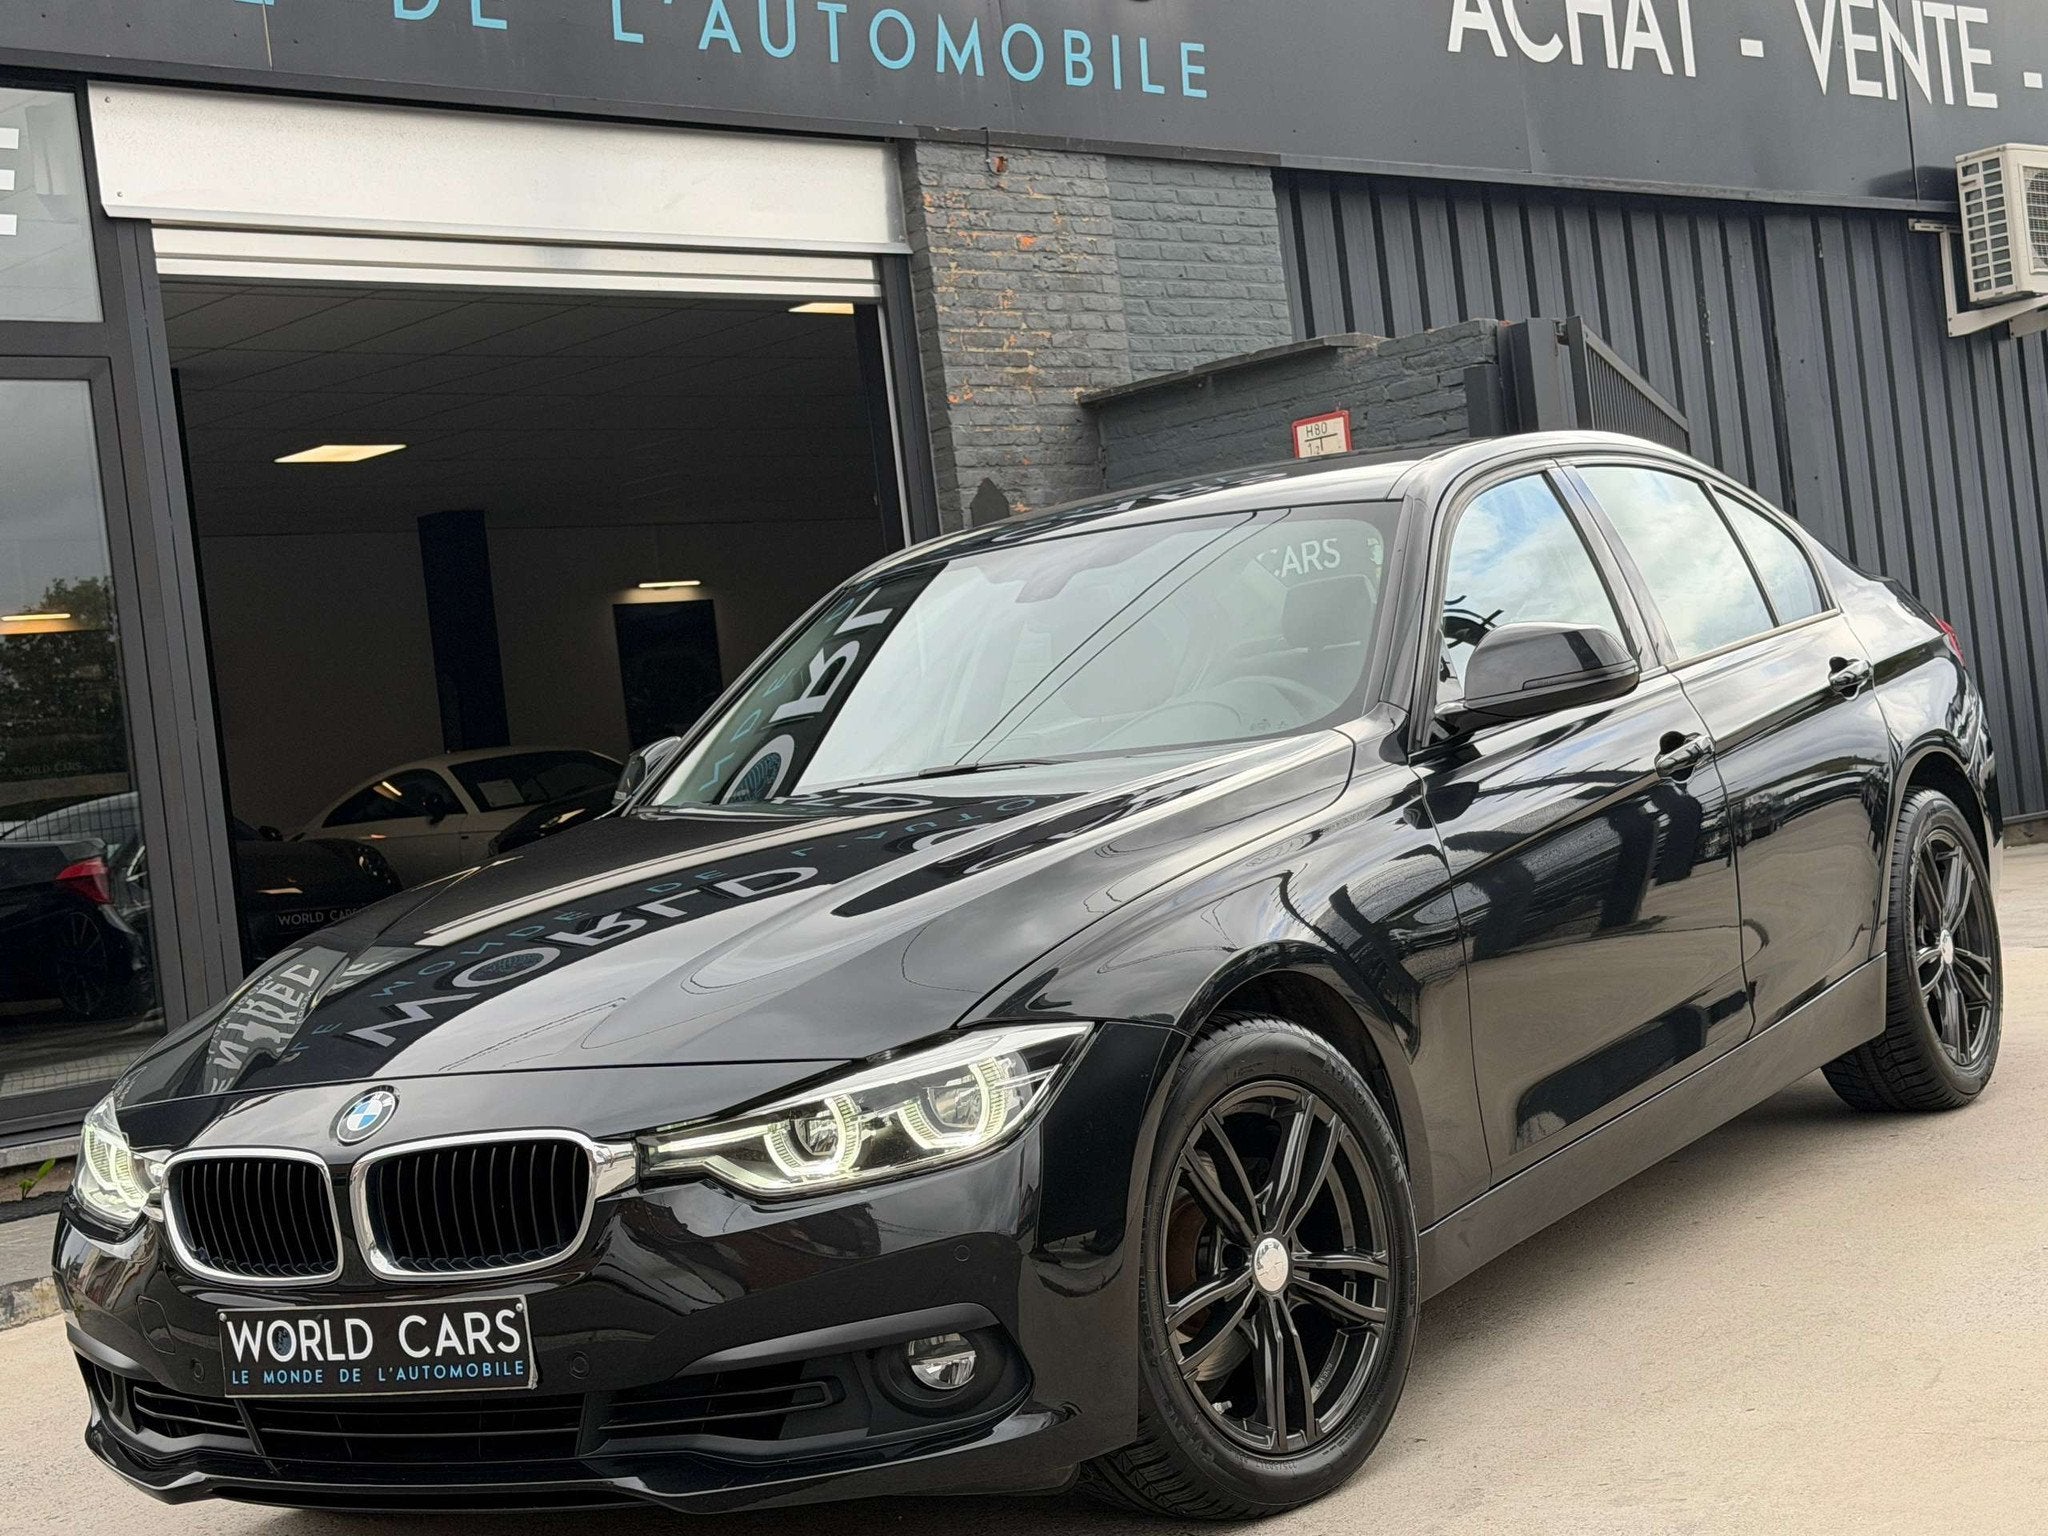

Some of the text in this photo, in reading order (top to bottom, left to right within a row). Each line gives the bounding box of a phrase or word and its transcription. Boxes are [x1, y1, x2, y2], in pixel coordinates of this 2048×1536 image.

[612, 0, 1207, 98] LAUTOMOBILE
[1794, 0, 1998, 109] VENTE
[278, 912, 324, 926] WORLD
[227, 1309, 521, 1363] WORLD CARS
[232, 1360, 524, 1385] LE MONDE DE L'AUTOMOBILE
